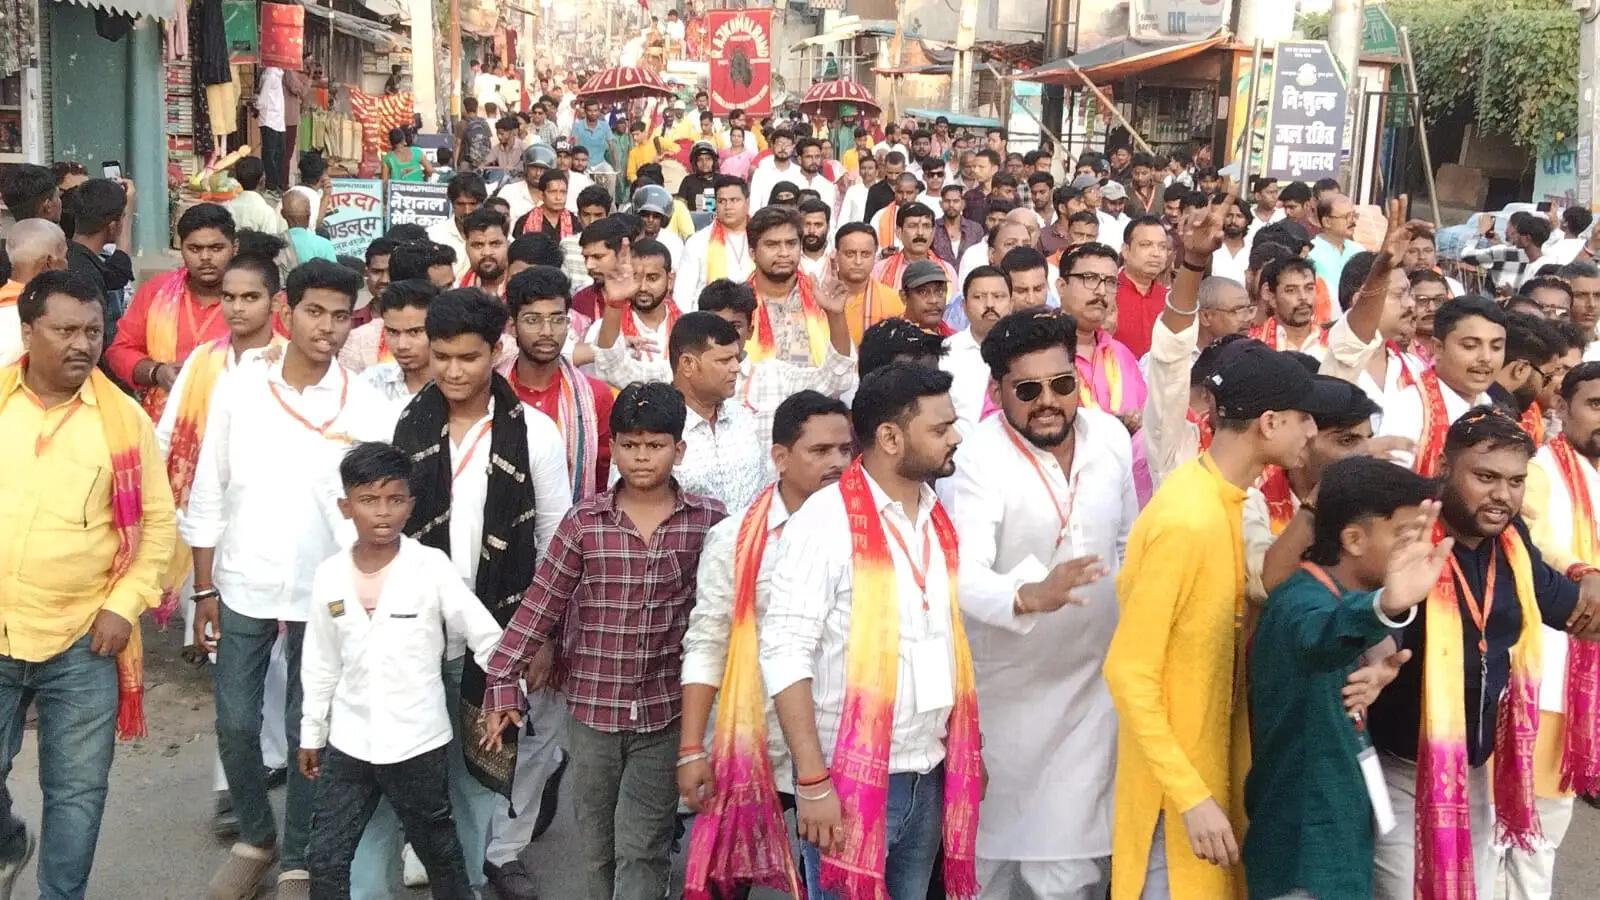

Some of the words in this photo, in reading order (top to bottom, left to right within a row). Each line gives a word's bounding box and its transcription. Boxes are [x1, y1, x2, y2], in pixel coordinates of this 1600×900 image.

[1281, 85, 1338, 117] निःशुल्क
[1275, 124, 1304, 144] जल
[1289, 152, 1336, 176] मूत्रालय
[390, 191, 446, 212] नेशनल
